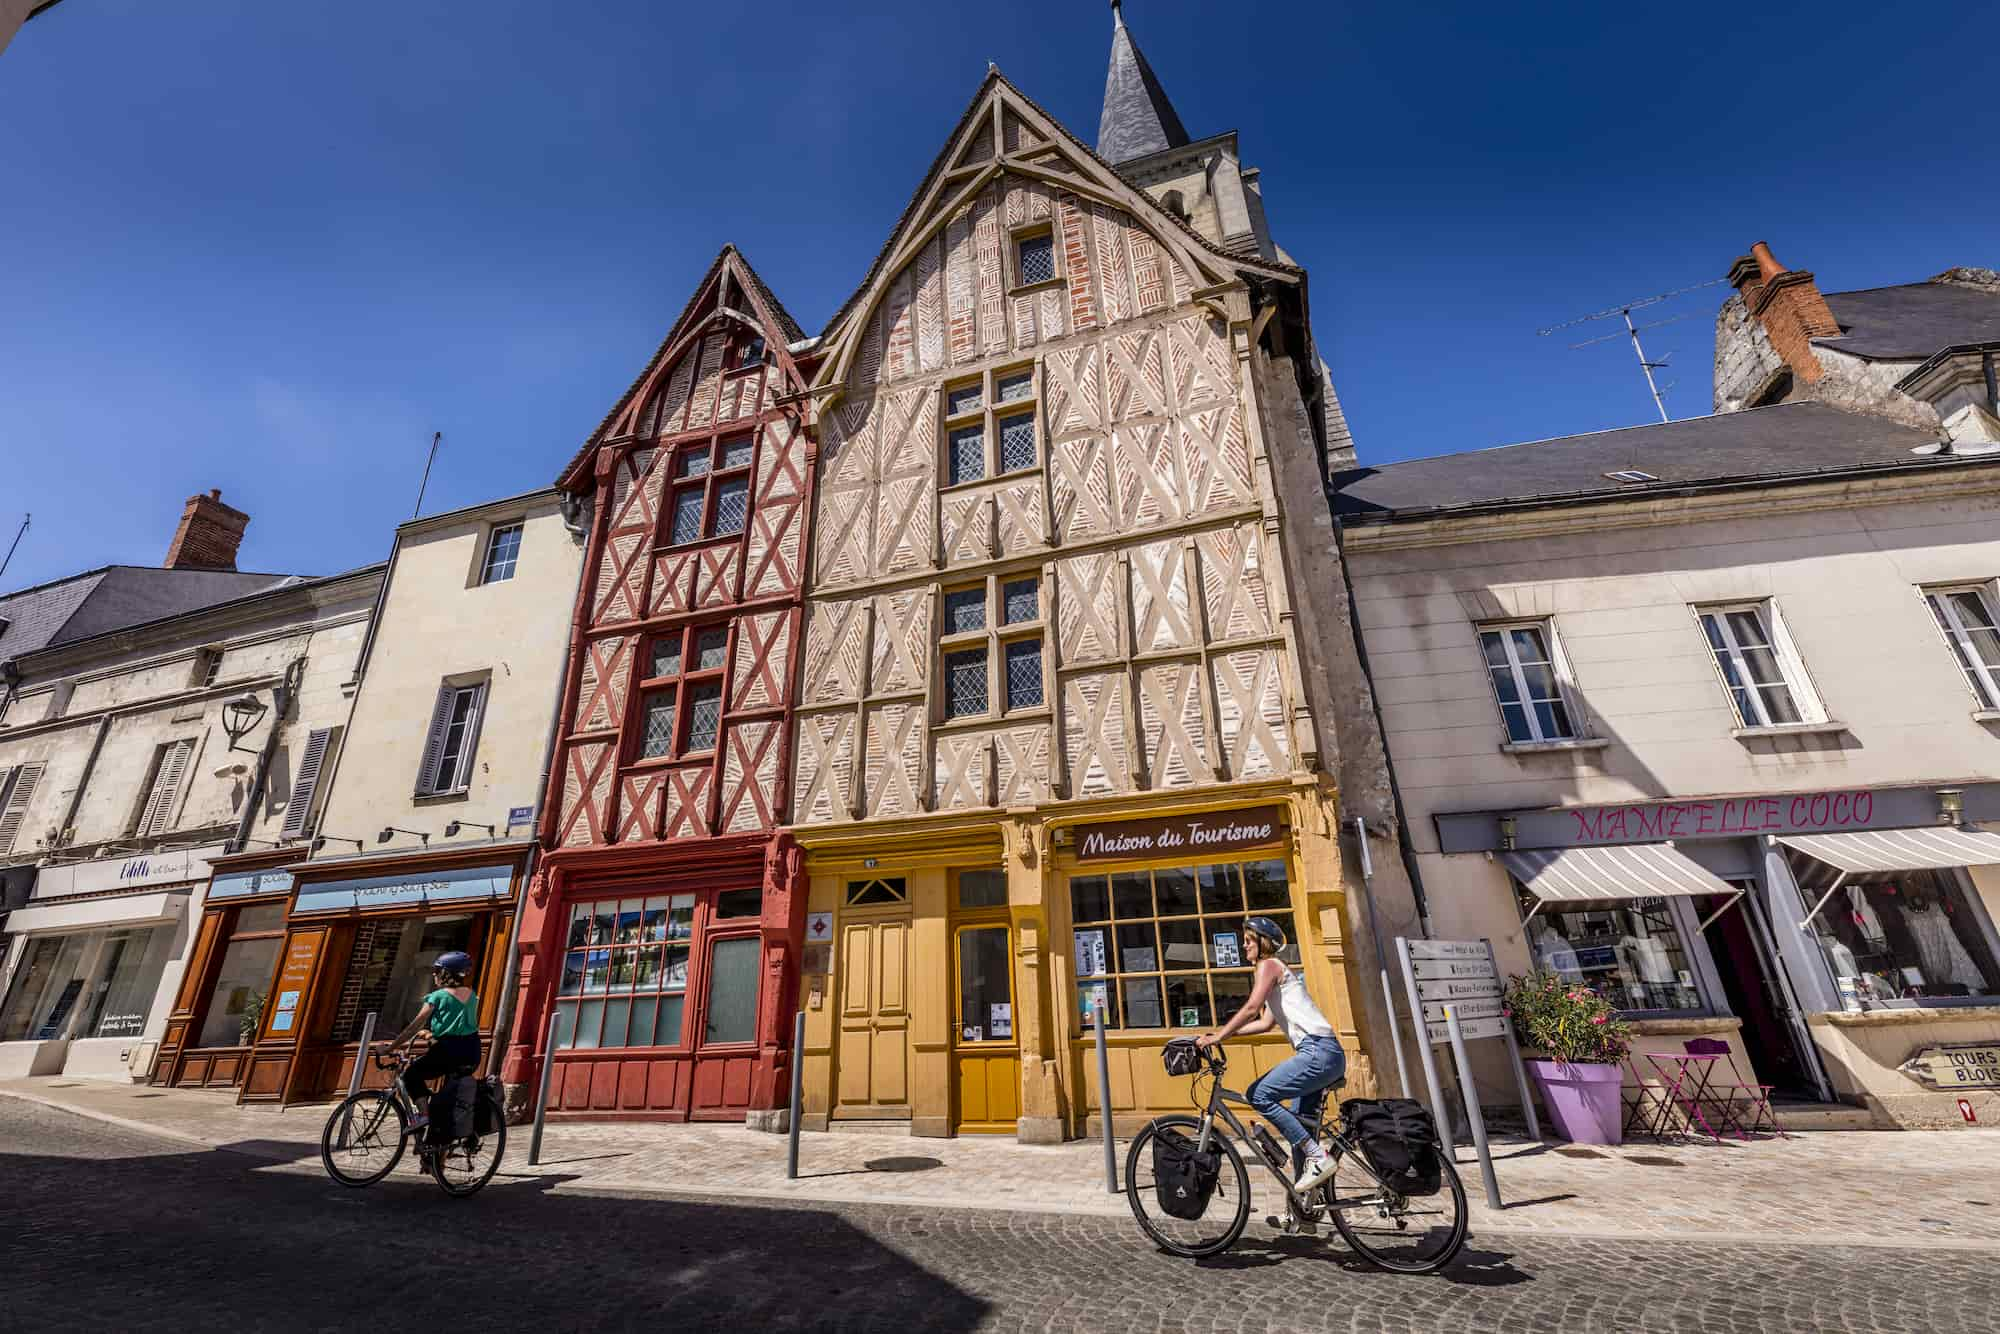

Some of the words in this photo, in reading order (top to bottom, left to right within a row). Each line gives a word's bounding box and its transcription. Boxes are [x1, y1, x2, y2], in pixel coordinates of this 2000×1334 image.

[1571, 799, 1782, 841] MAMZ'ELLE
[1790, 791, 1873, 827] COCO
[1082, 831, 1154, 855] Maison
[1157, 828, 1184, 847] du
[1187, 822, 1272, 845] Tourisme
[1945, 1051, 1998, 1065] TOURS
[1956, 1068, 2000, 1081] BLOIS
